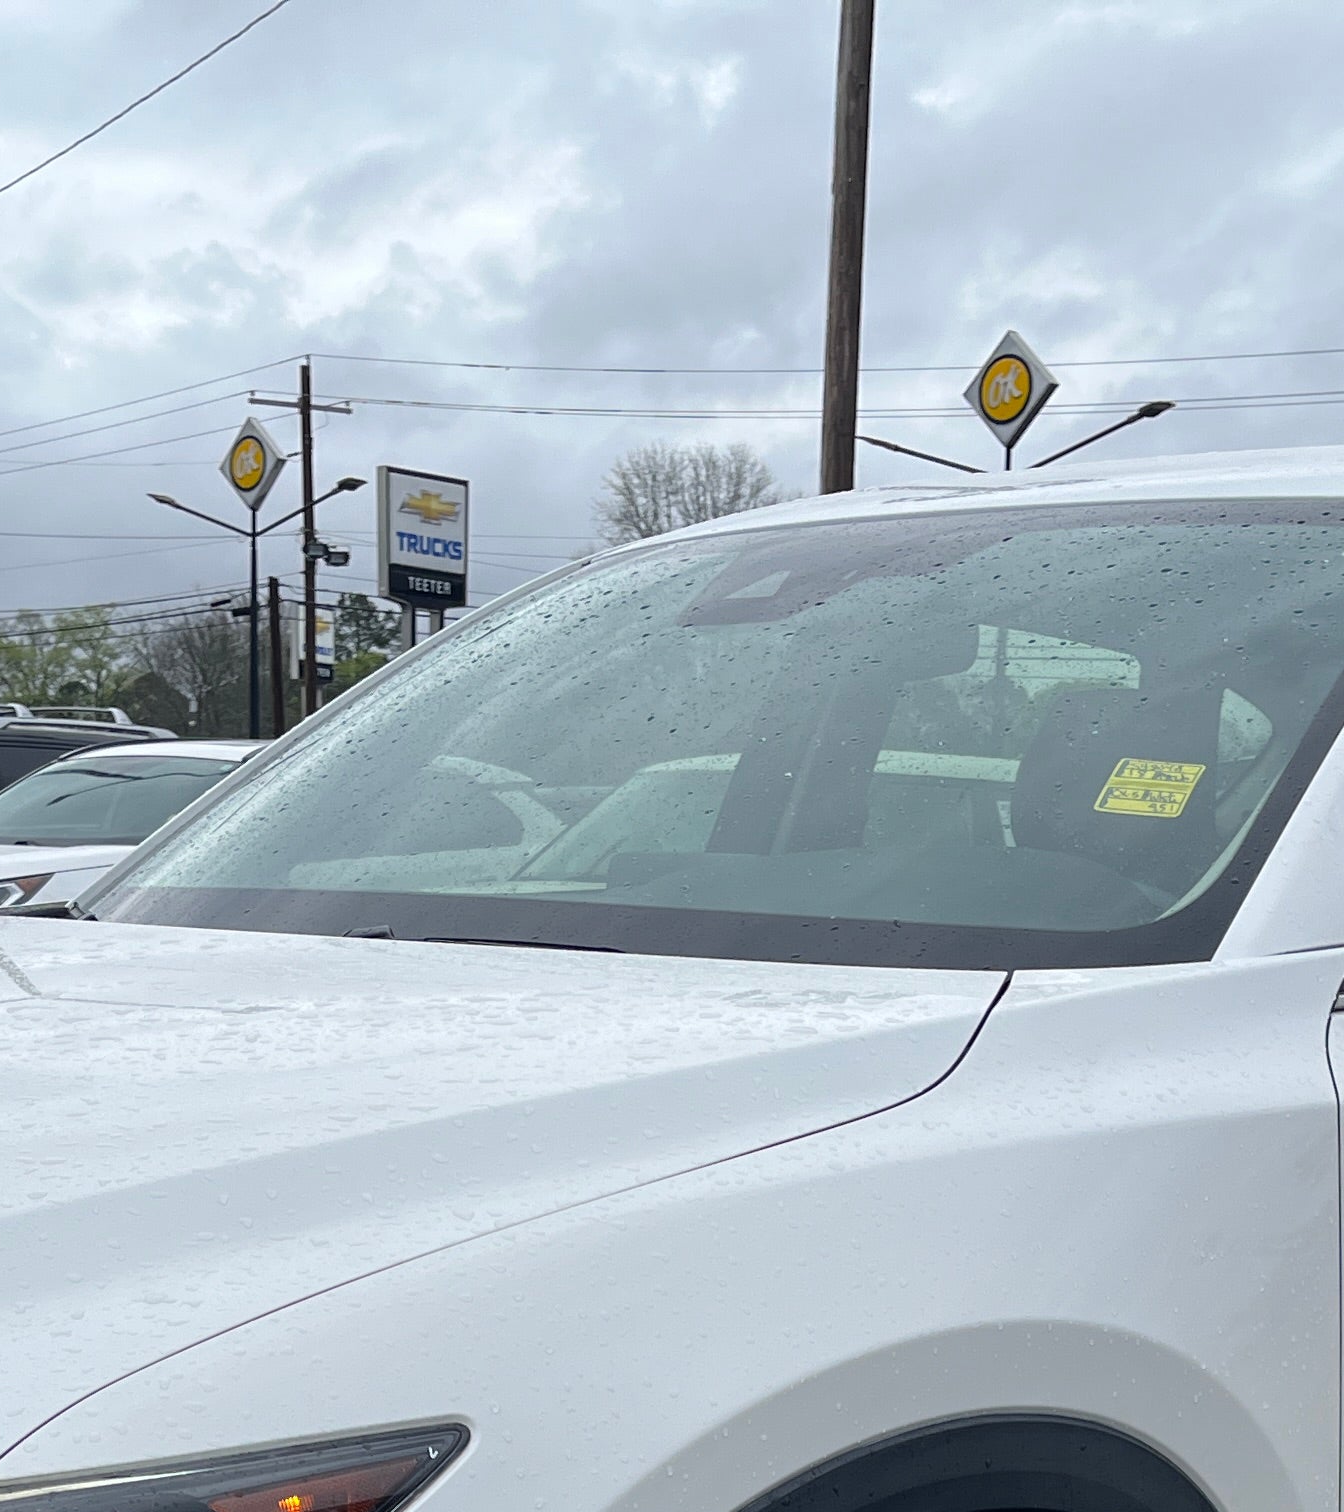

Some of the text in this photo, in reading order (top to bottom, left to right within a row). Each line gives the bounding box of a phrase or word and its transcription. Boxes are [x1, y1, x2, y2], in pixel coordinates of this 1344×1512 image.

[987, 363, 1023, 409] OK
[396, 531, 462, 560] TRUCKS
[408, 576, 452, 596] TEETER
